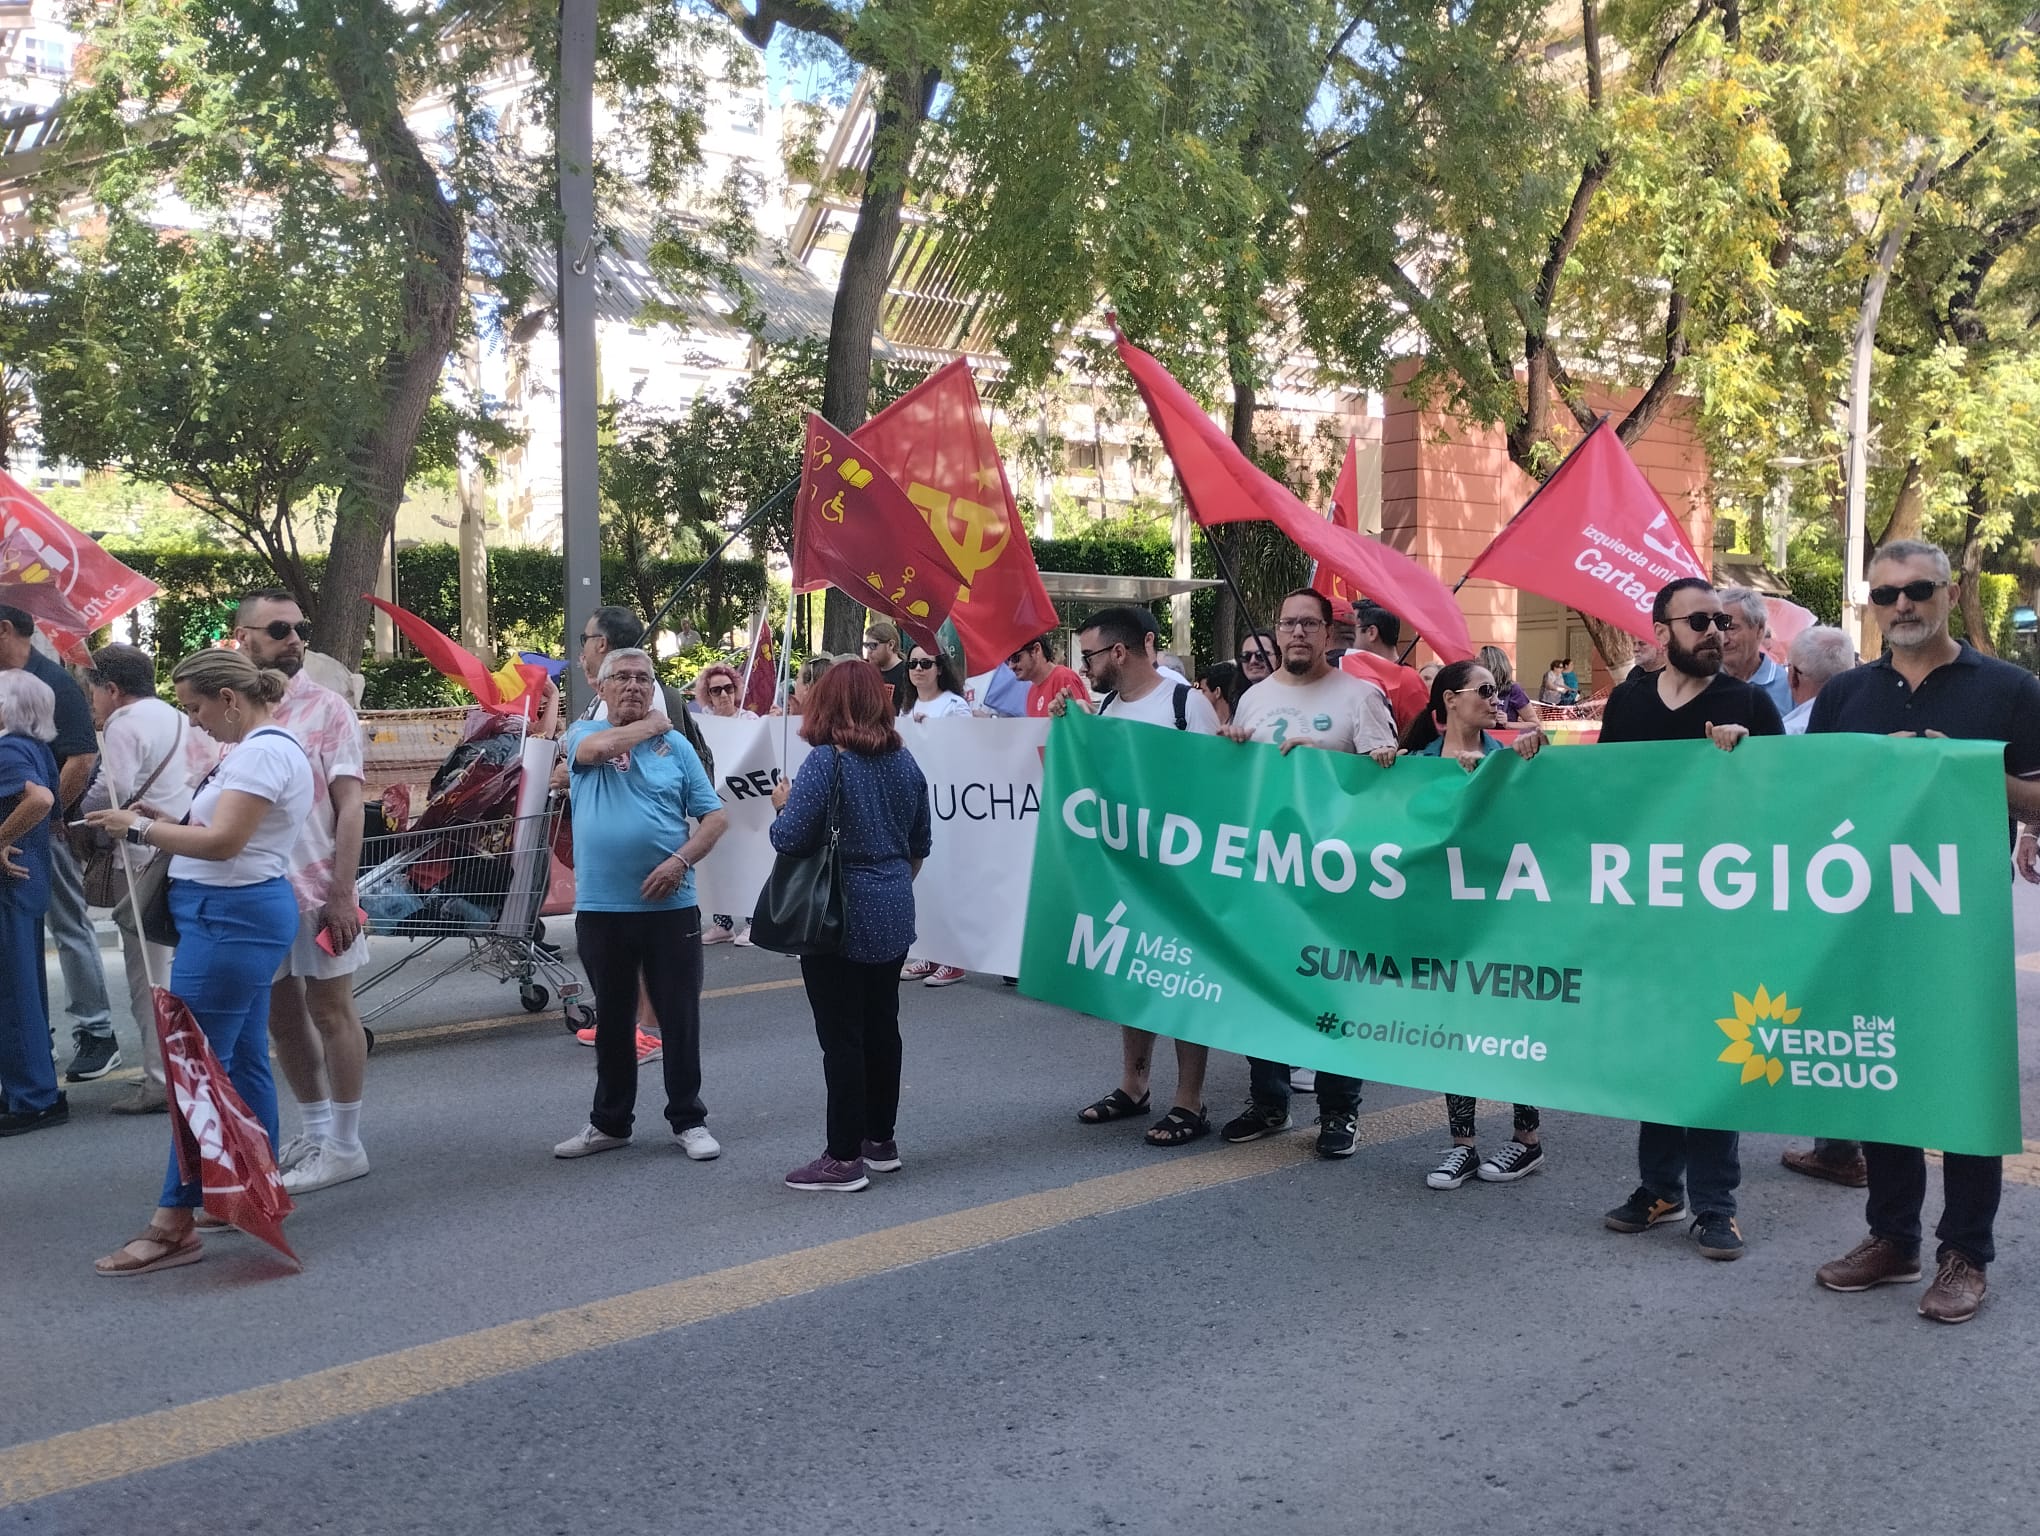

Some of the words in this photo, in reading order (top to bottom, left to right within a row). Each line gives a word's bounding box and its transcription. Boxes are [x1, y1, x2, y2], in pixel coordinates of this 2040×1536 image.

[1581, 523, 1649, 567] izquierda
[1574, 548, 1659, 613] Cartag
[934, 783, 1040, 820] UCHA
[1062, 788, 1406, 900] CUIDEMOS
[1446, 843, 1551, 902] LA
[1589, 818, 1961, 915] REGIÓN
[1135, 931, 1193, 966] Más
[1126, 958, 1222, 1003] Región
[1296, 945, 1404, 988] SUMA
[1411, 957, 1458, 993] EN
[1466, 960, 1583, 1004] VERDE
[1315, 1011, 1548, 1062] #coaliciónverde
[1758, 1027, 1897, 1059] VERDES
[1853, 1015, 1895, 1032] RdM
[1790, 1060, 1898, 1091] EQUO
